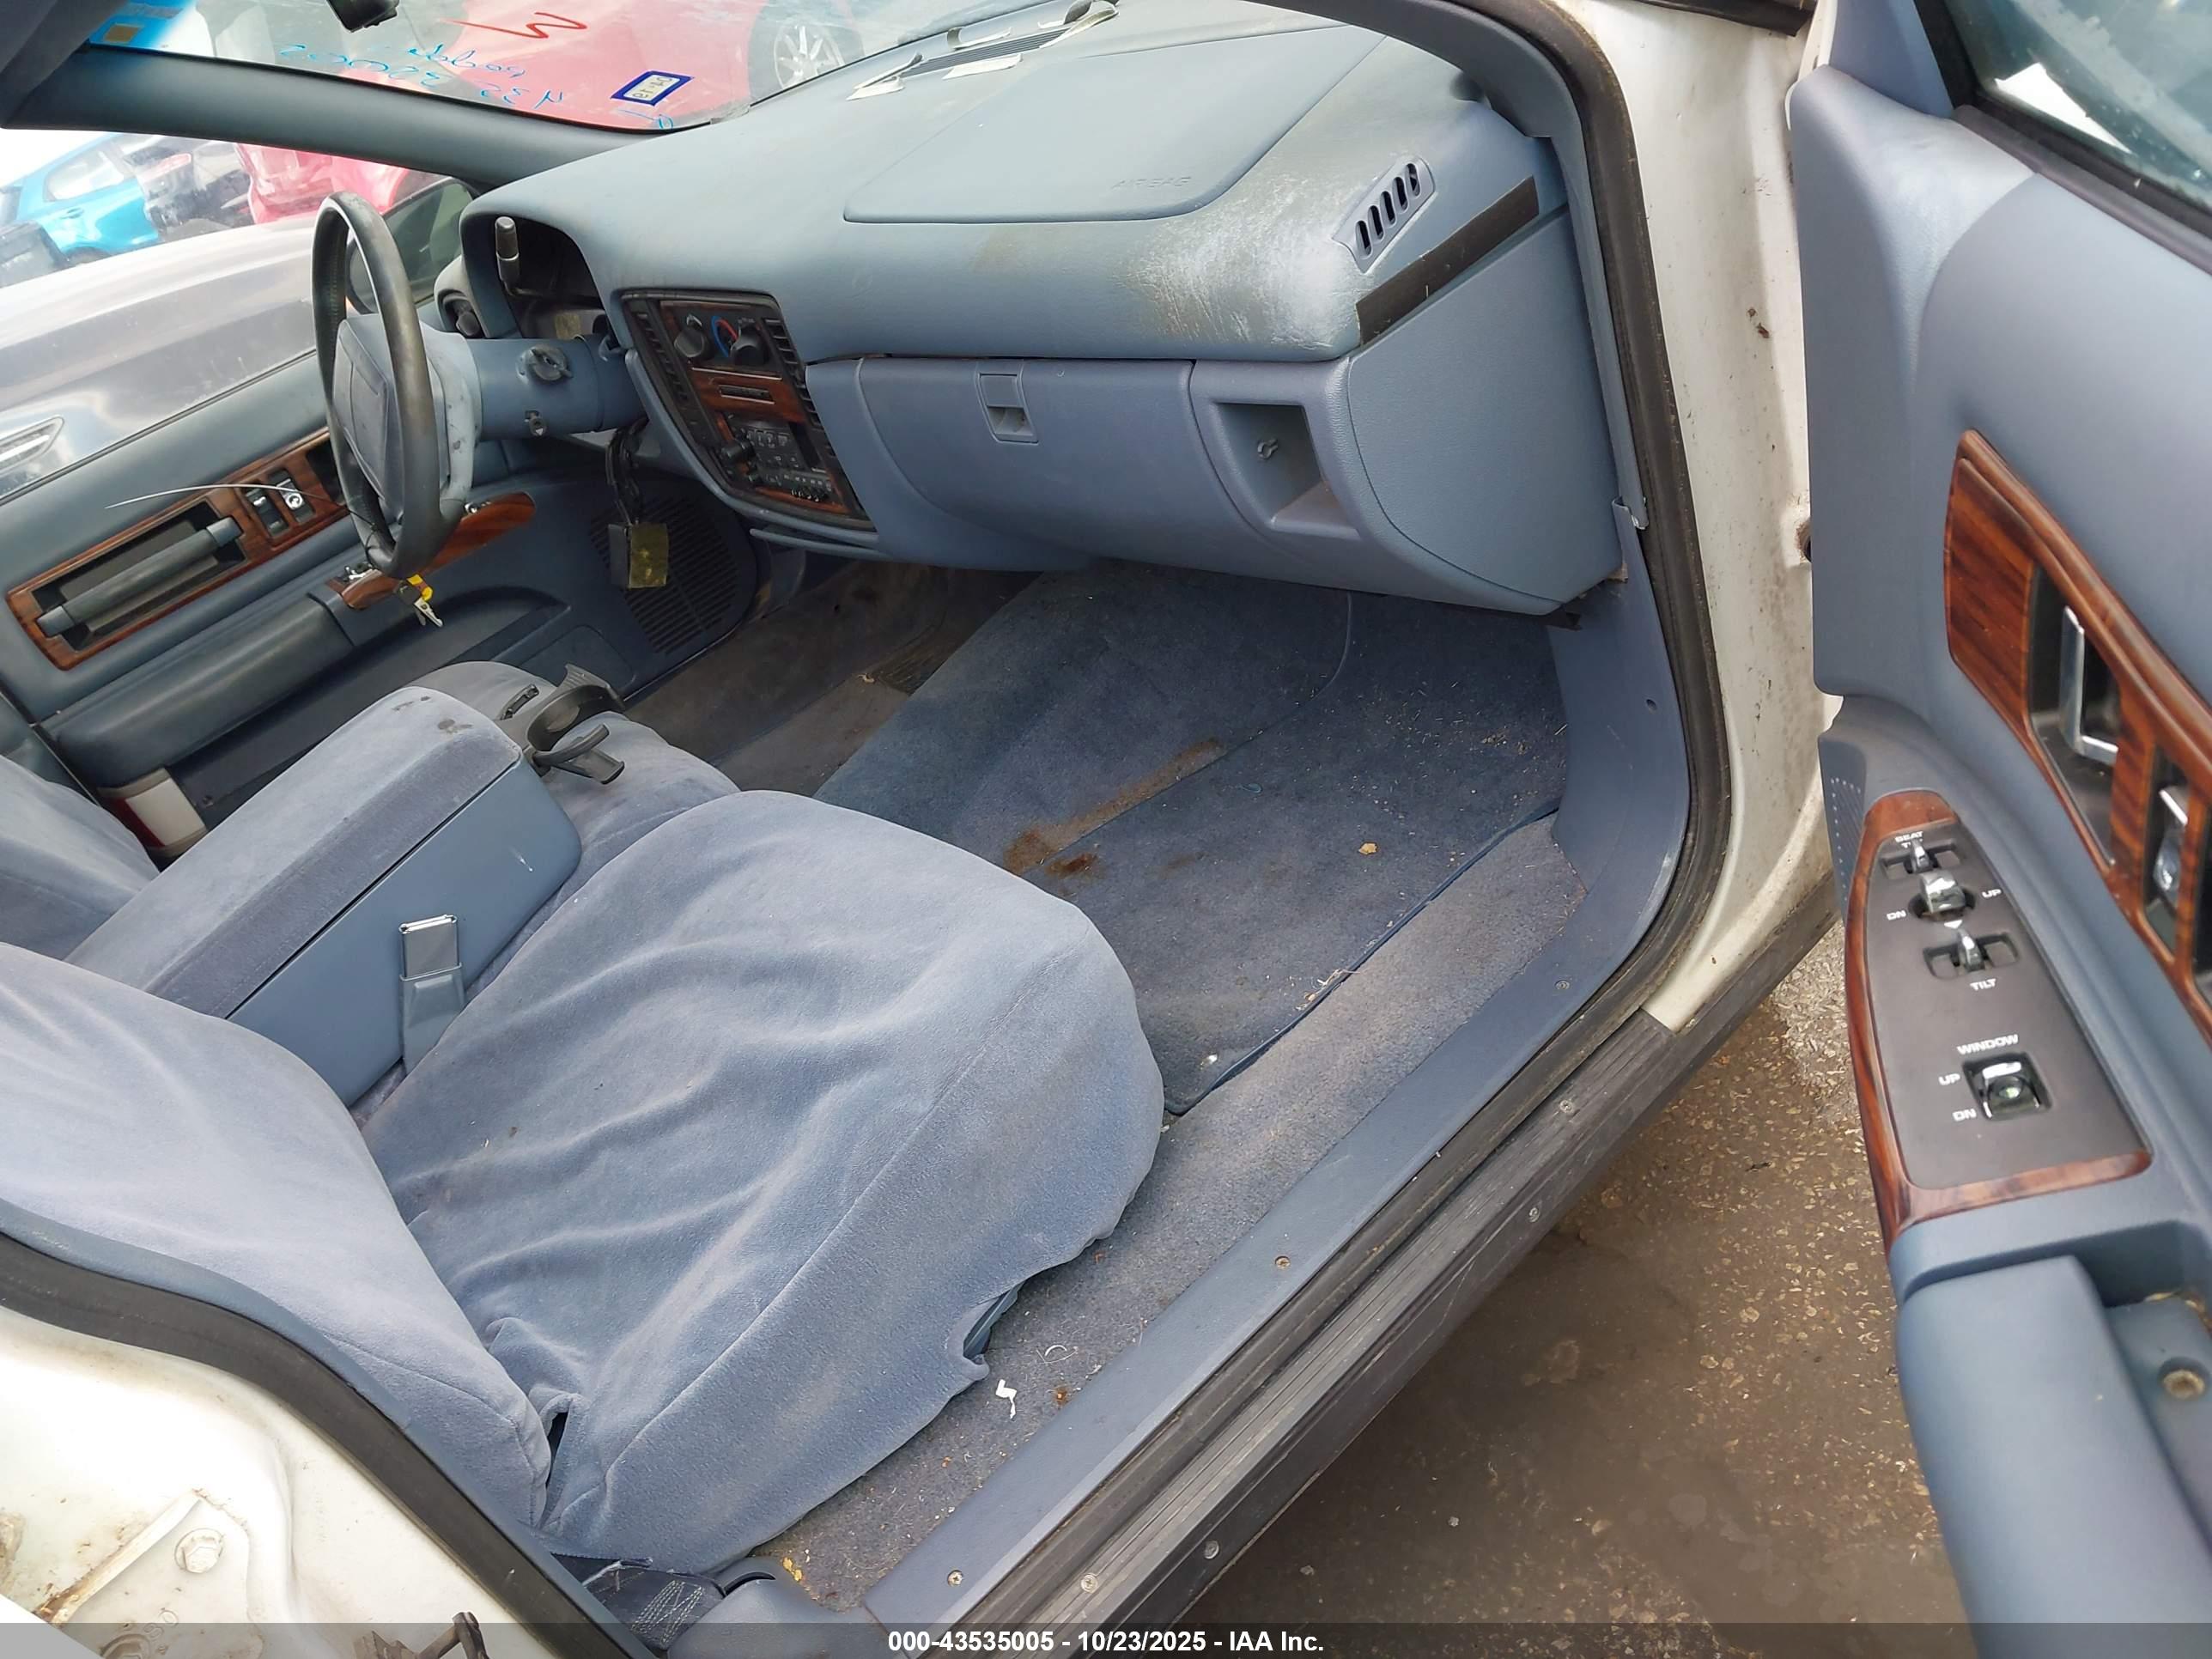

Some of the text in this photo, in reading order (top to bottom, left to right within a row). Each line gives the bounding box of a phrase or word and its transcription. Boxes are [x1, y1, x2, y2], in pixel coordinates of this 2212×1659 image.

[1981, 888, 2002, 899] UP
[1887, 909, 1906, 921] DN
[1970, 978, 1996, 991] TILT
[1957, 1034, 2019, 1055] WINDOW
[1938, 1073, 1960, 1085] UP
[1952, 1109, 1977, 1121] DN
